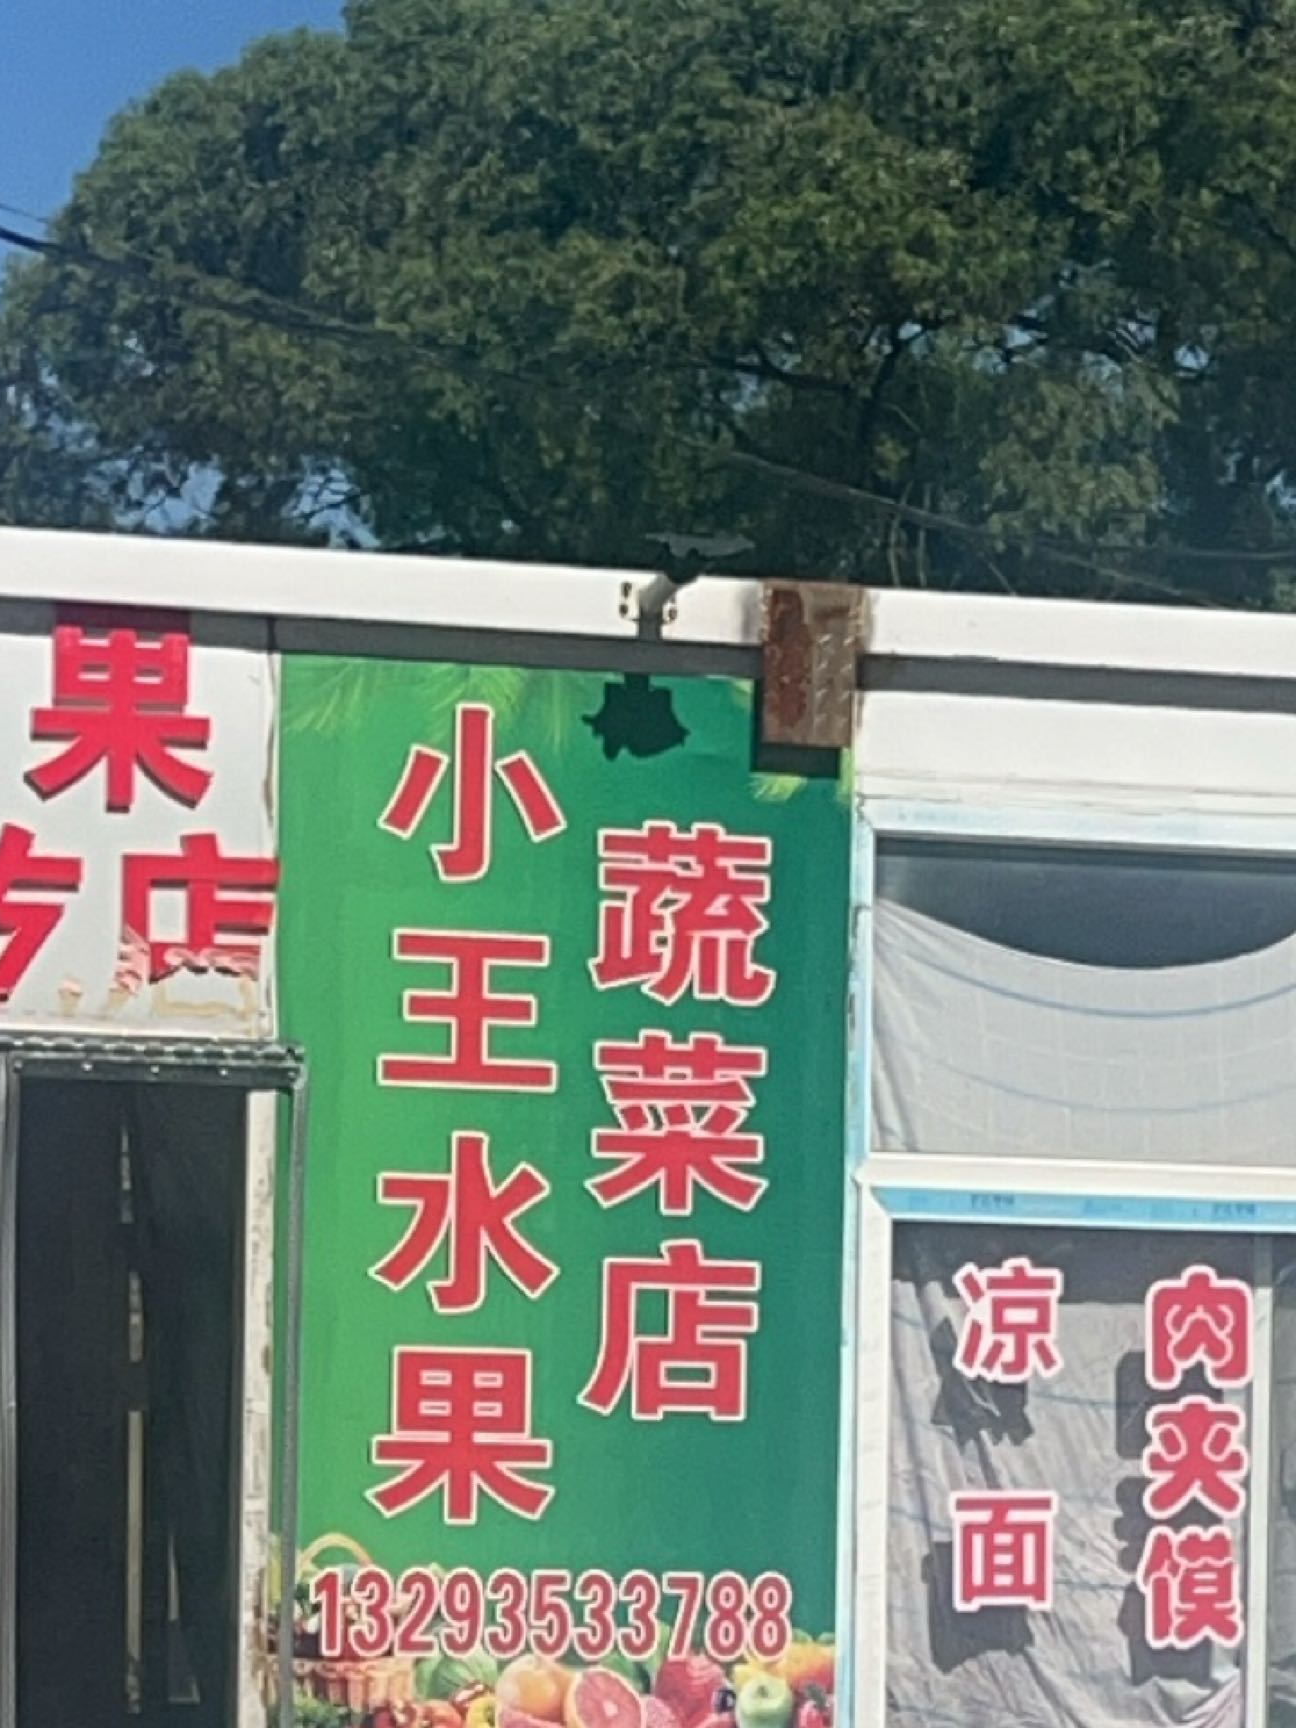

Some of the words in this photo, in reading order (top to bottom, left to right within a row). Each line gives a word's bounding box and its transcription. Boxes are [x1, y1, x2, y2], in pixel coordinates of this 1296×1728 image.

[366, 703, 567, 1525] 小王水果
[576, 820, 777, 1420] 蔬菜店
[310, 1568, 792, 1662] 13293533788
[950, 1258, 1062, 1613] 凉面
[1139, 1265, 1253, 1648] 肉夹馍
